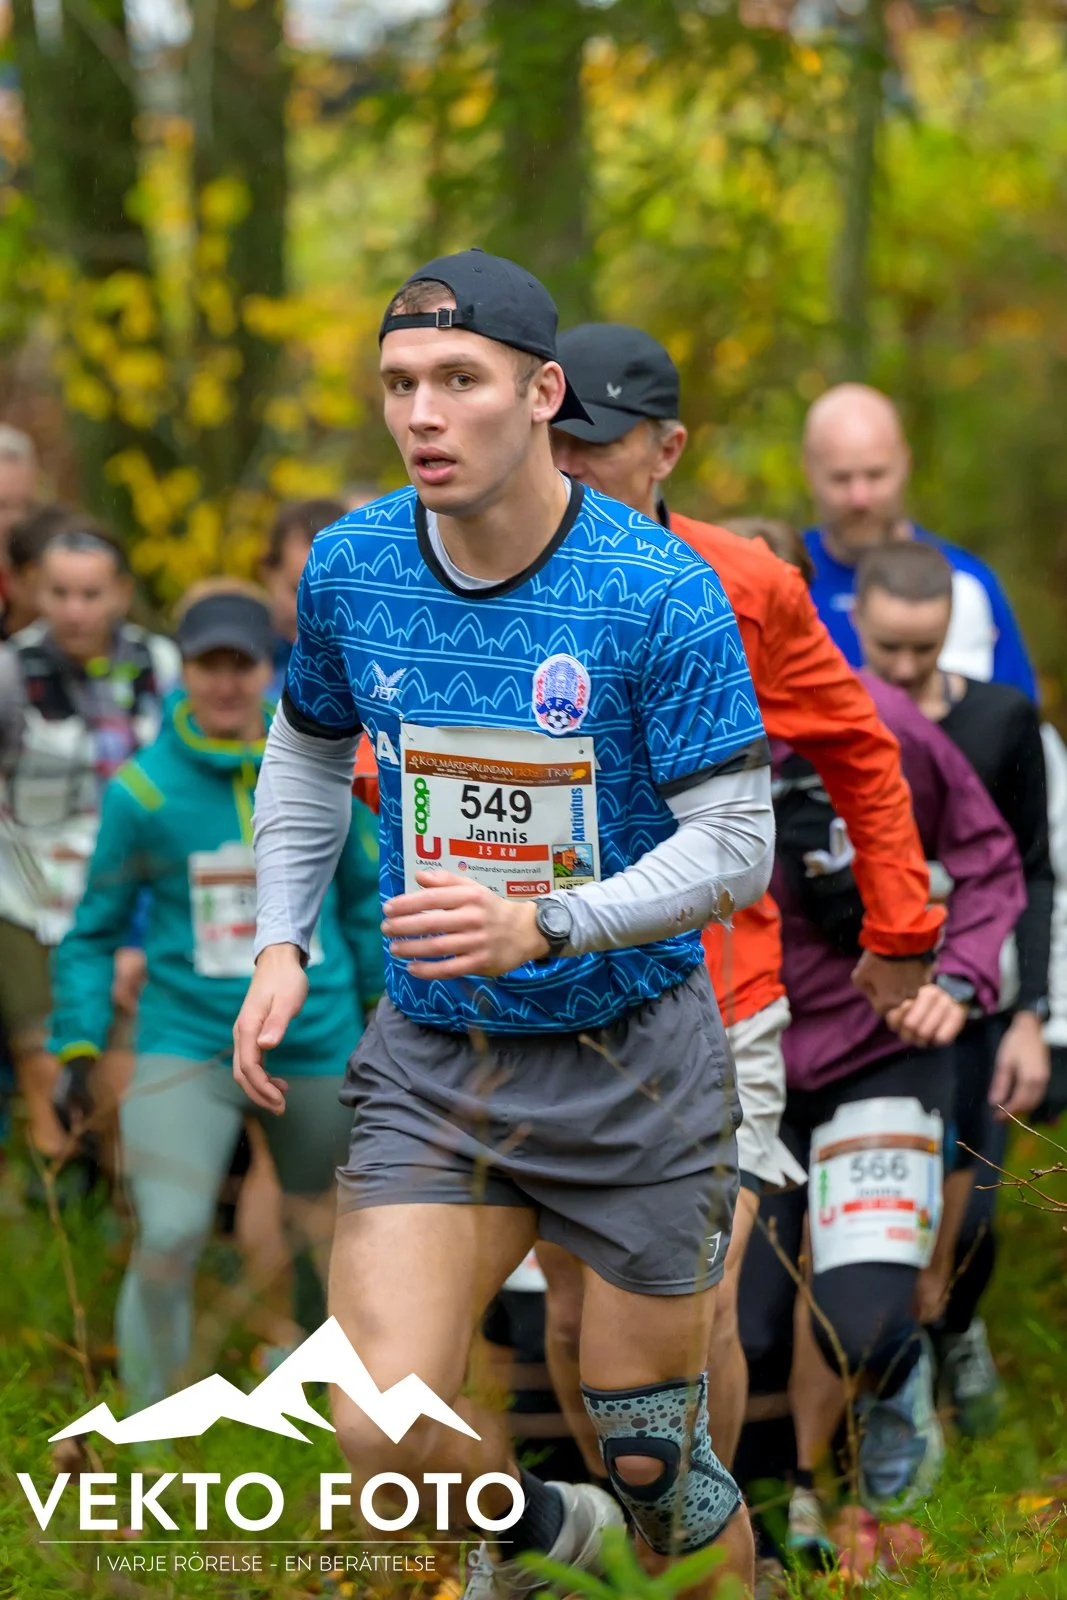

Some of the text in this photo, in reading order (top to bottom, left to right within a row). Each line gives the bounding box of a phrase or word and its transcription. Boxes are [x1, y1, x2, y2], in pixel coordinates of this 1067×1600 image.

[460, 784, 532, 824] 549
[570, 787, 586, 842] Aktivitus
[466, 824, 528, 844] Jannis
[478, 845, 517, 858] 15 KM
[850, 1154, 909, 1183] 566
